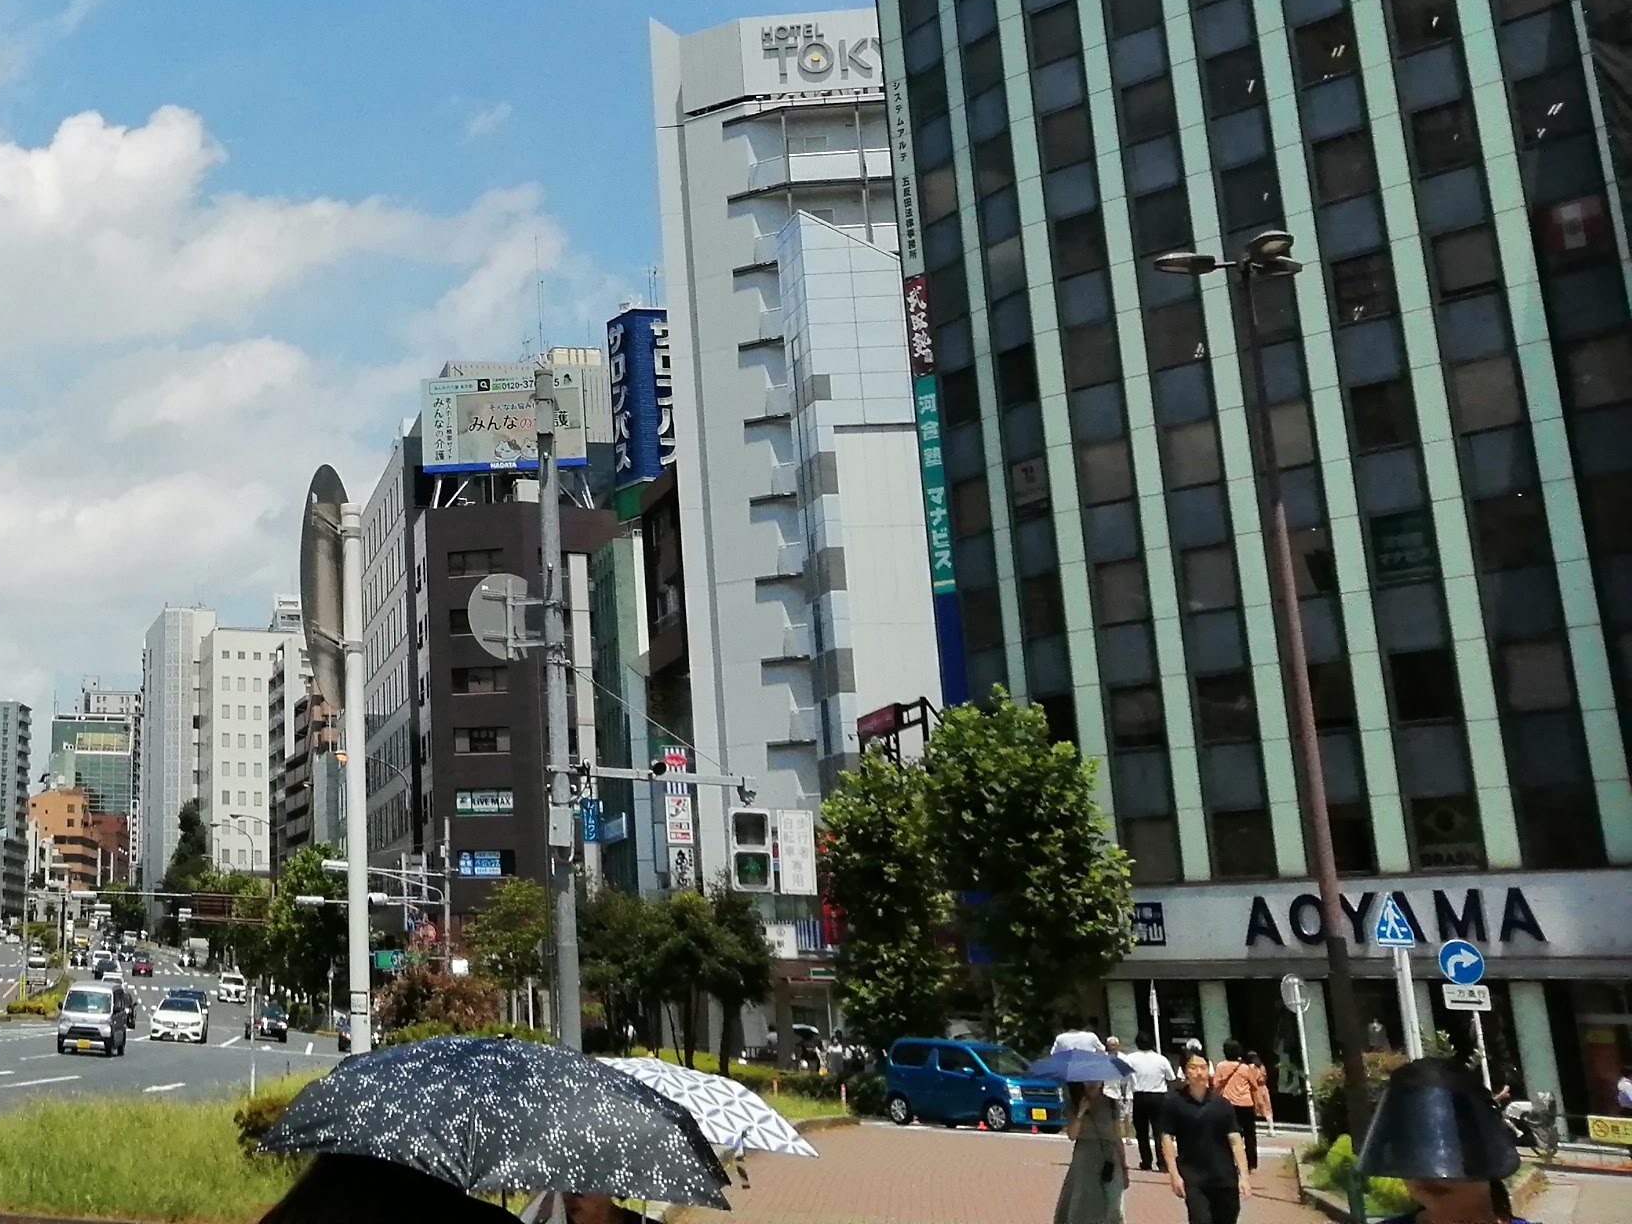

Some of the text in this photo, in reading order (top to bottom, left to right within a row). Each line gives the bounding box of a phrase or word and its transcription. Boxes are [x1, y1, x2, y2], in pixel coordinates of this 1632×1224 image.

[761, 23, 824, 43] HOTEL
[433, 397, 445, 461] みんなの介護
[468, 410, 569, 432] みんなの護
[919, 393, 943, 467] 河合塾
[926, 486, 953, 571] マナビス
[1447, 989, 1486, 999] 一方通行
